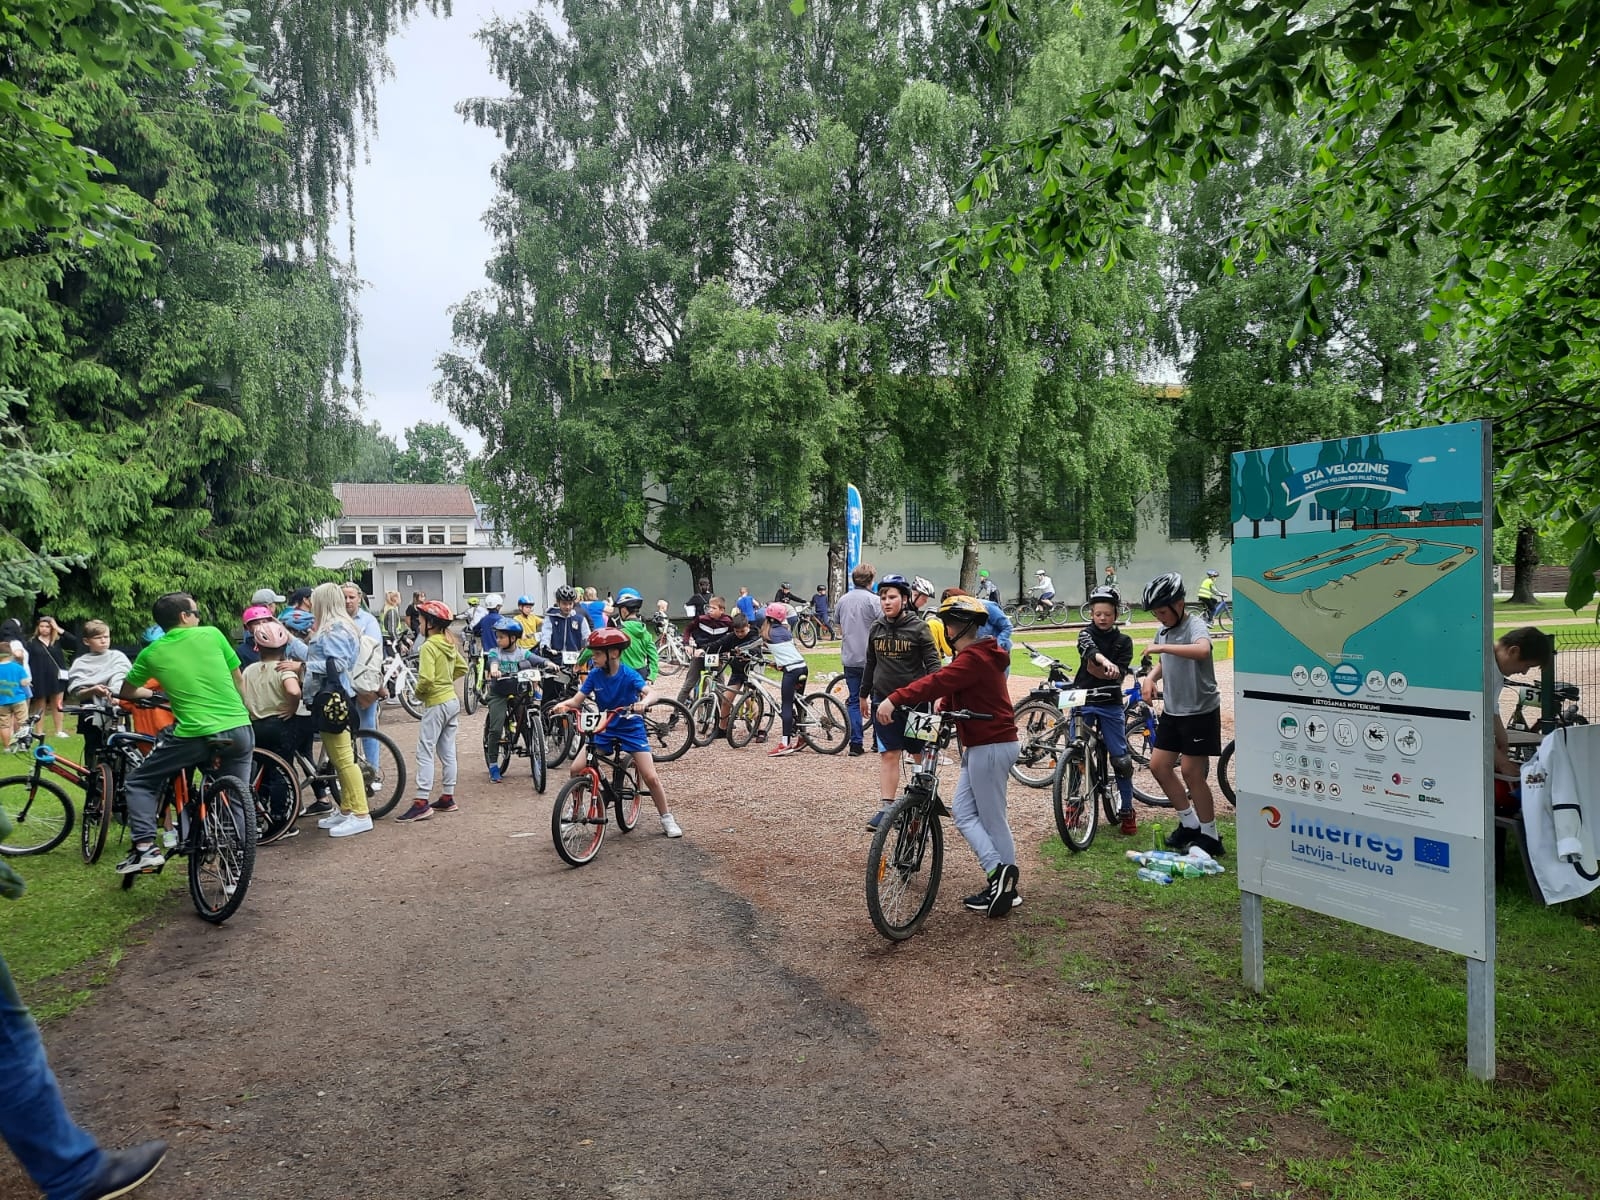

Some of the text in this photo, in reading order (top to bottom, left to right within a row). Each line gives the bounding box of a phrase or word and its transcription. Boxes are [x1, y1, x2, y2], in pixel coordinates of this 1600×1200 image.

[1302, 462, 1390, 483] BTA VELOZINIS
[707, 656, 717, 664] 62
[1068, 691, 1076, 702] 4
[1347, 702, 1380, 711] NOTEIKUMI
[585, 714, 602, 727] 57
[914, 716, 932, 733] 14
[1291, 810, 1403, 862] Interreg
